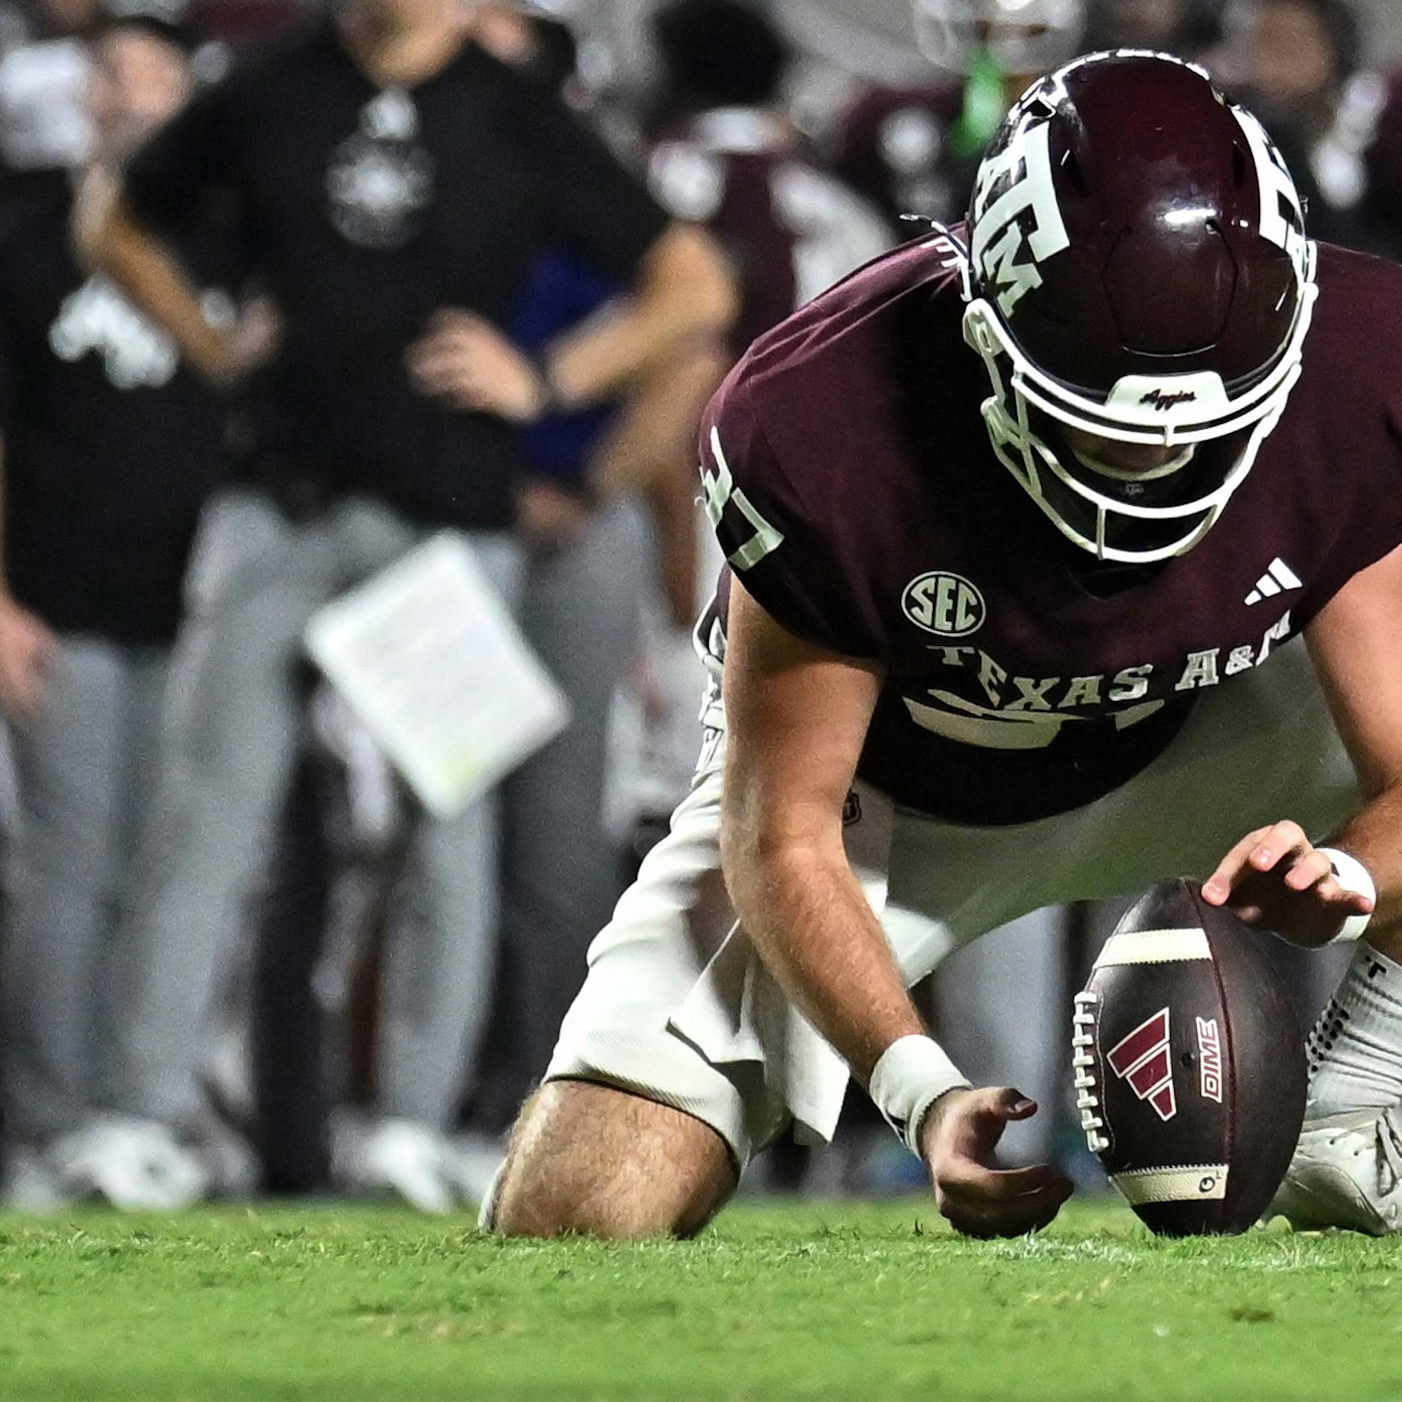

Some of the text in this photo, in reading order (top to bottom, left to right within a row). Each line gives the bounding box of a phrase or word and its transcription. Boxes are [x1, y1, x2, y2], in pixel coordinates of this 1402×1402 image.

[907, 575, 980, 633] SEC
[925, 645, 1154, 712] TEXAS
[1195, 1015, 1223, 1104] DIME
